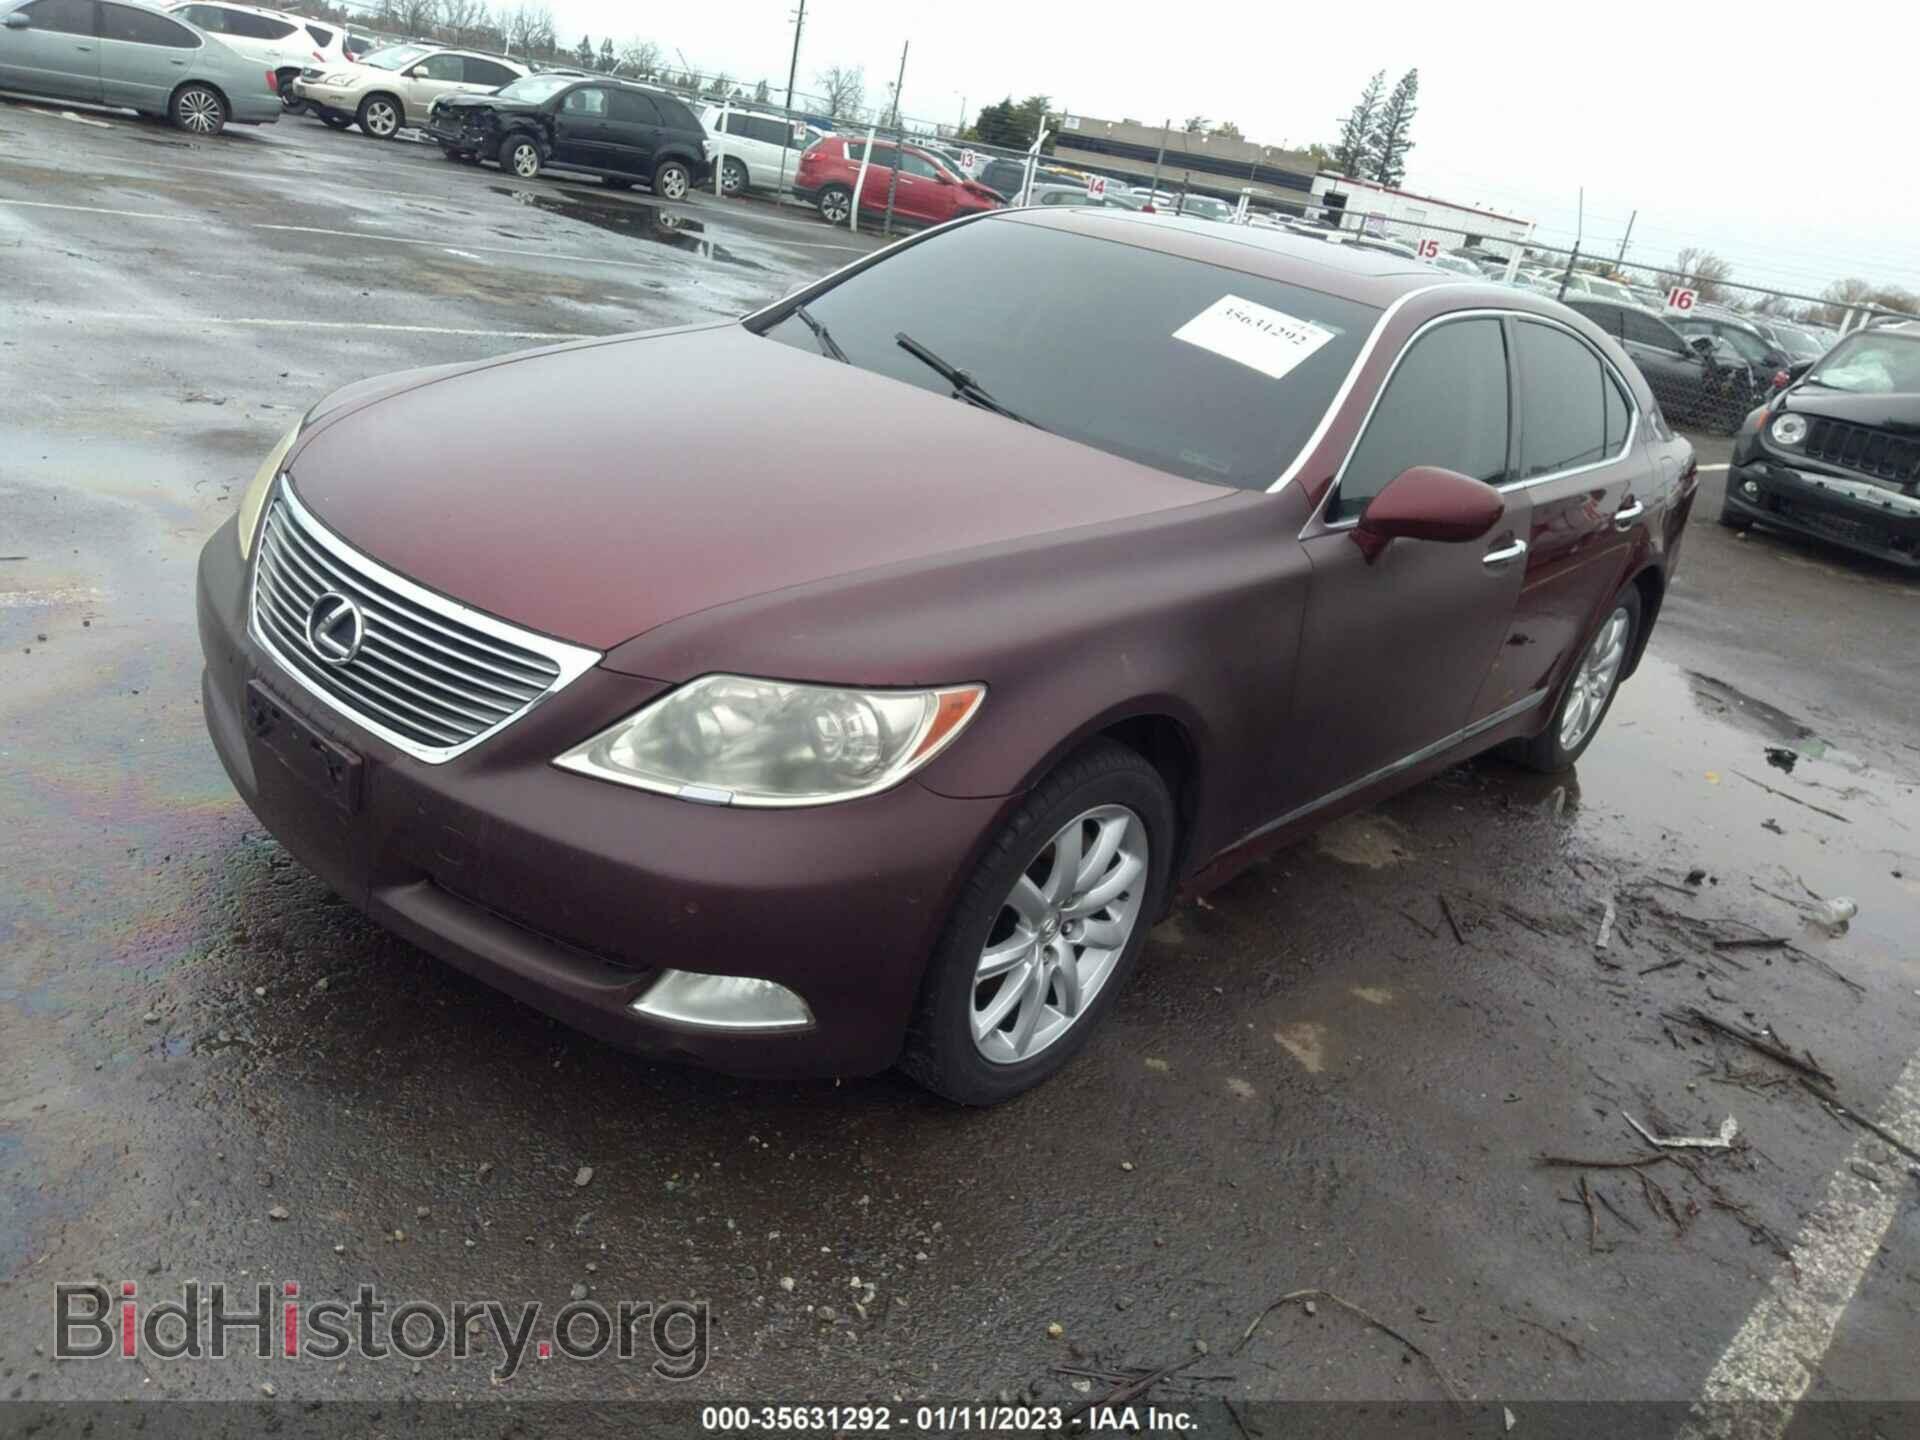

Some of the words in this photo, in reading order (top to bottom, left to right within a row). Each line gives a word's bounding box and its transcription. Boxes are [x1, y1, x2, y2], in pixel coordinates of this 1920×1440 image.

[961, 153, 975, 168] 13
[1090, 178, 1105, 194] 14
[1418, 239, 1439, 258] 15
[1669, 288, 1694, 310] 16
